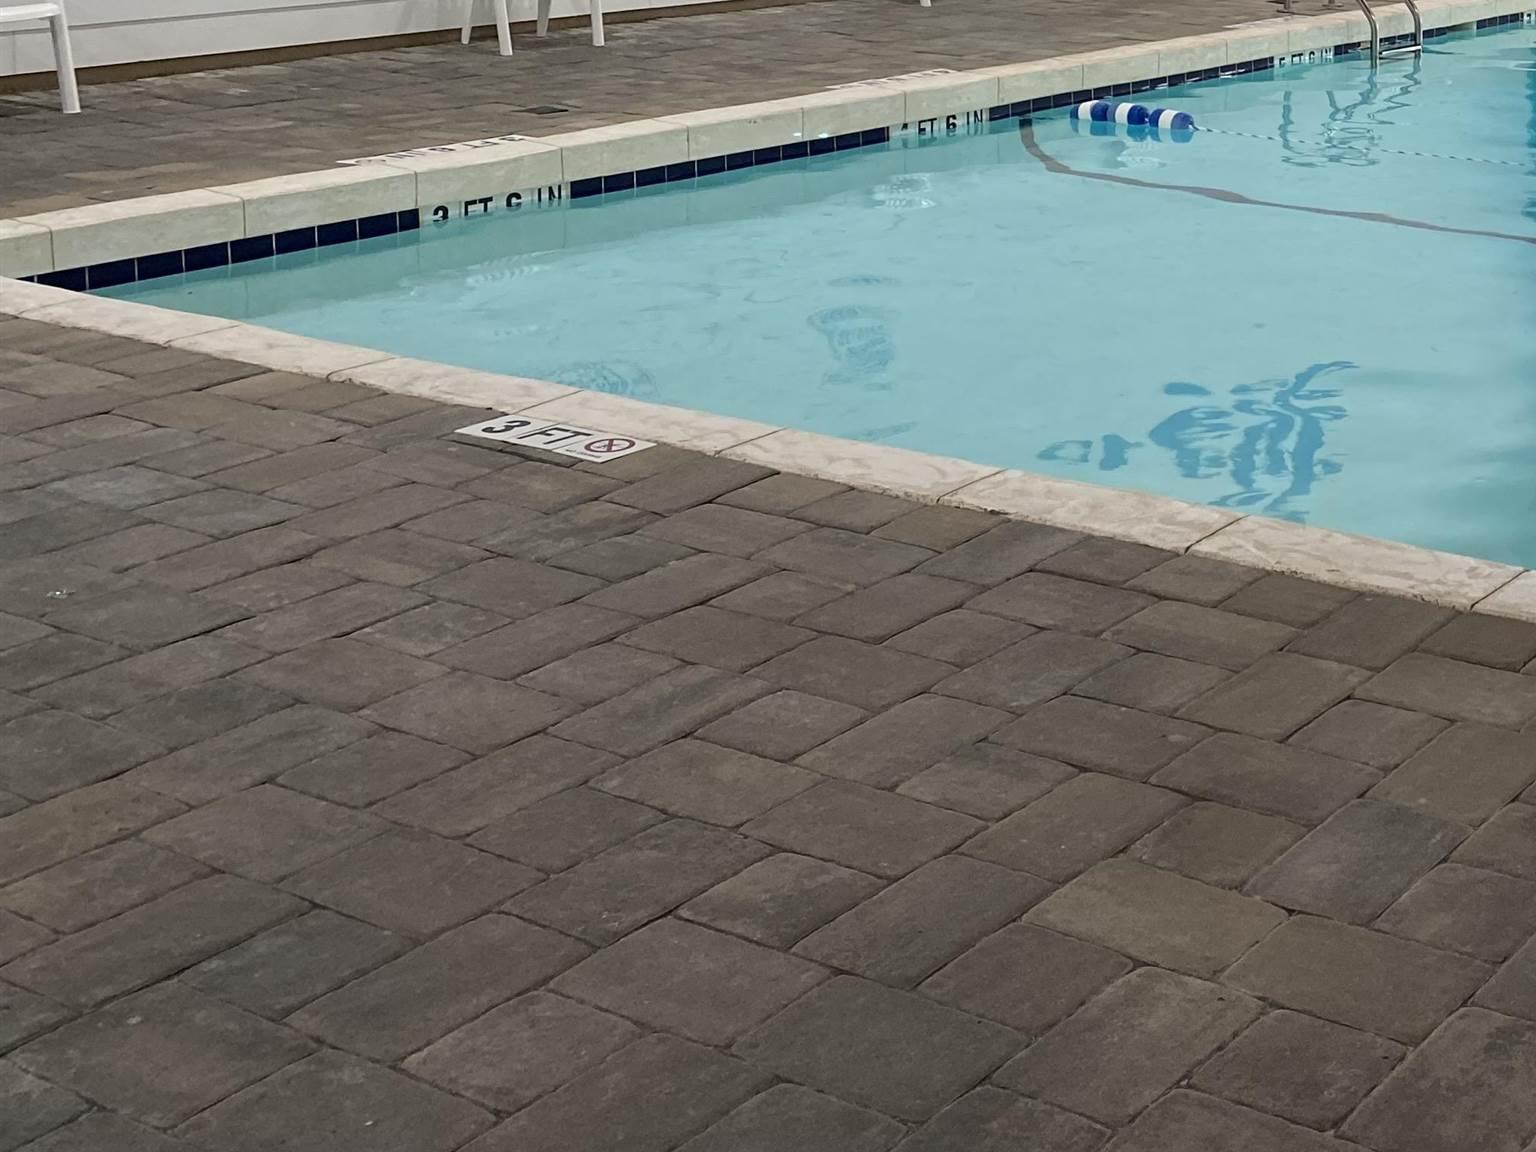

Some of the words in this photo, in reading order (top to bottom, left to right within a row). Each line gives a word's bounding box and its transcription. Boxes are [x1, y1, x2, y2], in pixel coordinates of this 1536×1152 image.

[918, 117, 937, 135] FT
[945, 114, 957, 131] 6
[966, 108, 983, 125] IN
[432, 205, 449, 222] 3
[464, 196, 494, 217] FT
[537, 184, 562, 203] IN
[481, 420, 532, 434] 3
[517, 427, 593, 445] FT
